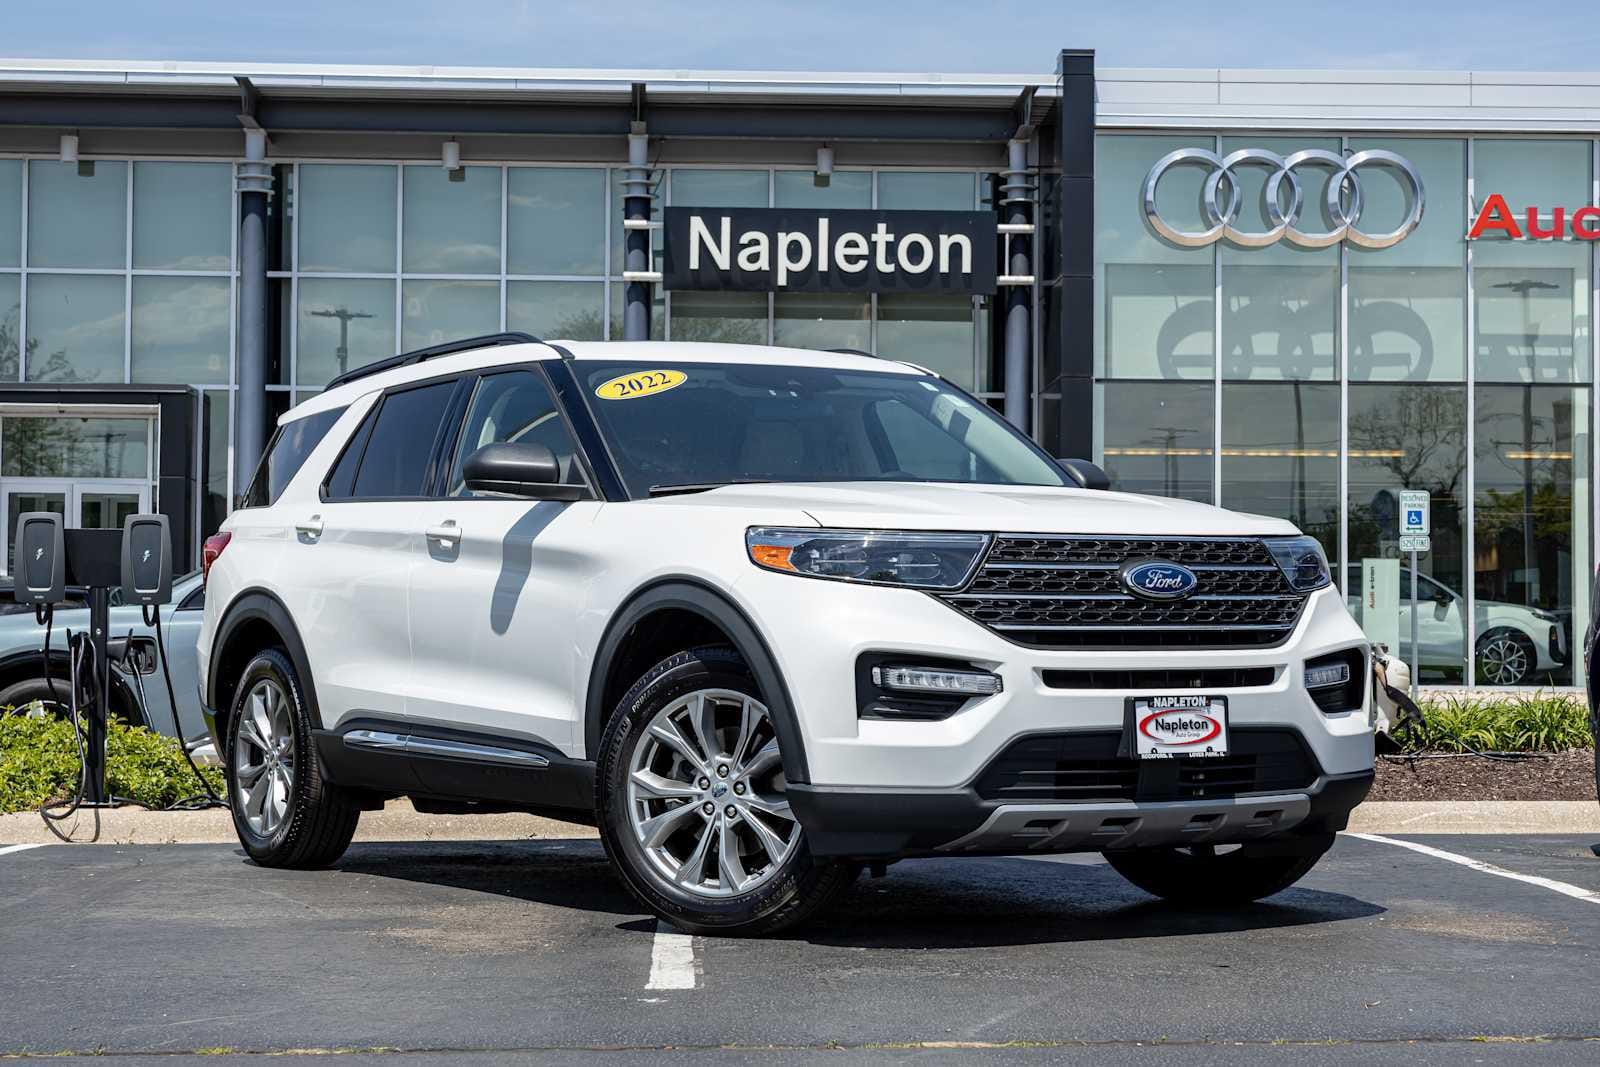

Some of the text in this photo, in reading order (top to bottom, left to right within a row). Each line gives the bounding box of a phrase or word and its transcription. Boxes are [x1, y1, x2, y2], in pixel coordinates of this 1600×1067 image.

[688, 215, 972, 287] Napleton
[613, 372, 671, 396] 2022
[1145, 569, 1183, 589] Ford
[1153, 696, 1206, 707] NAPLETON
[1155, 717, 1208, 733] Napleton
